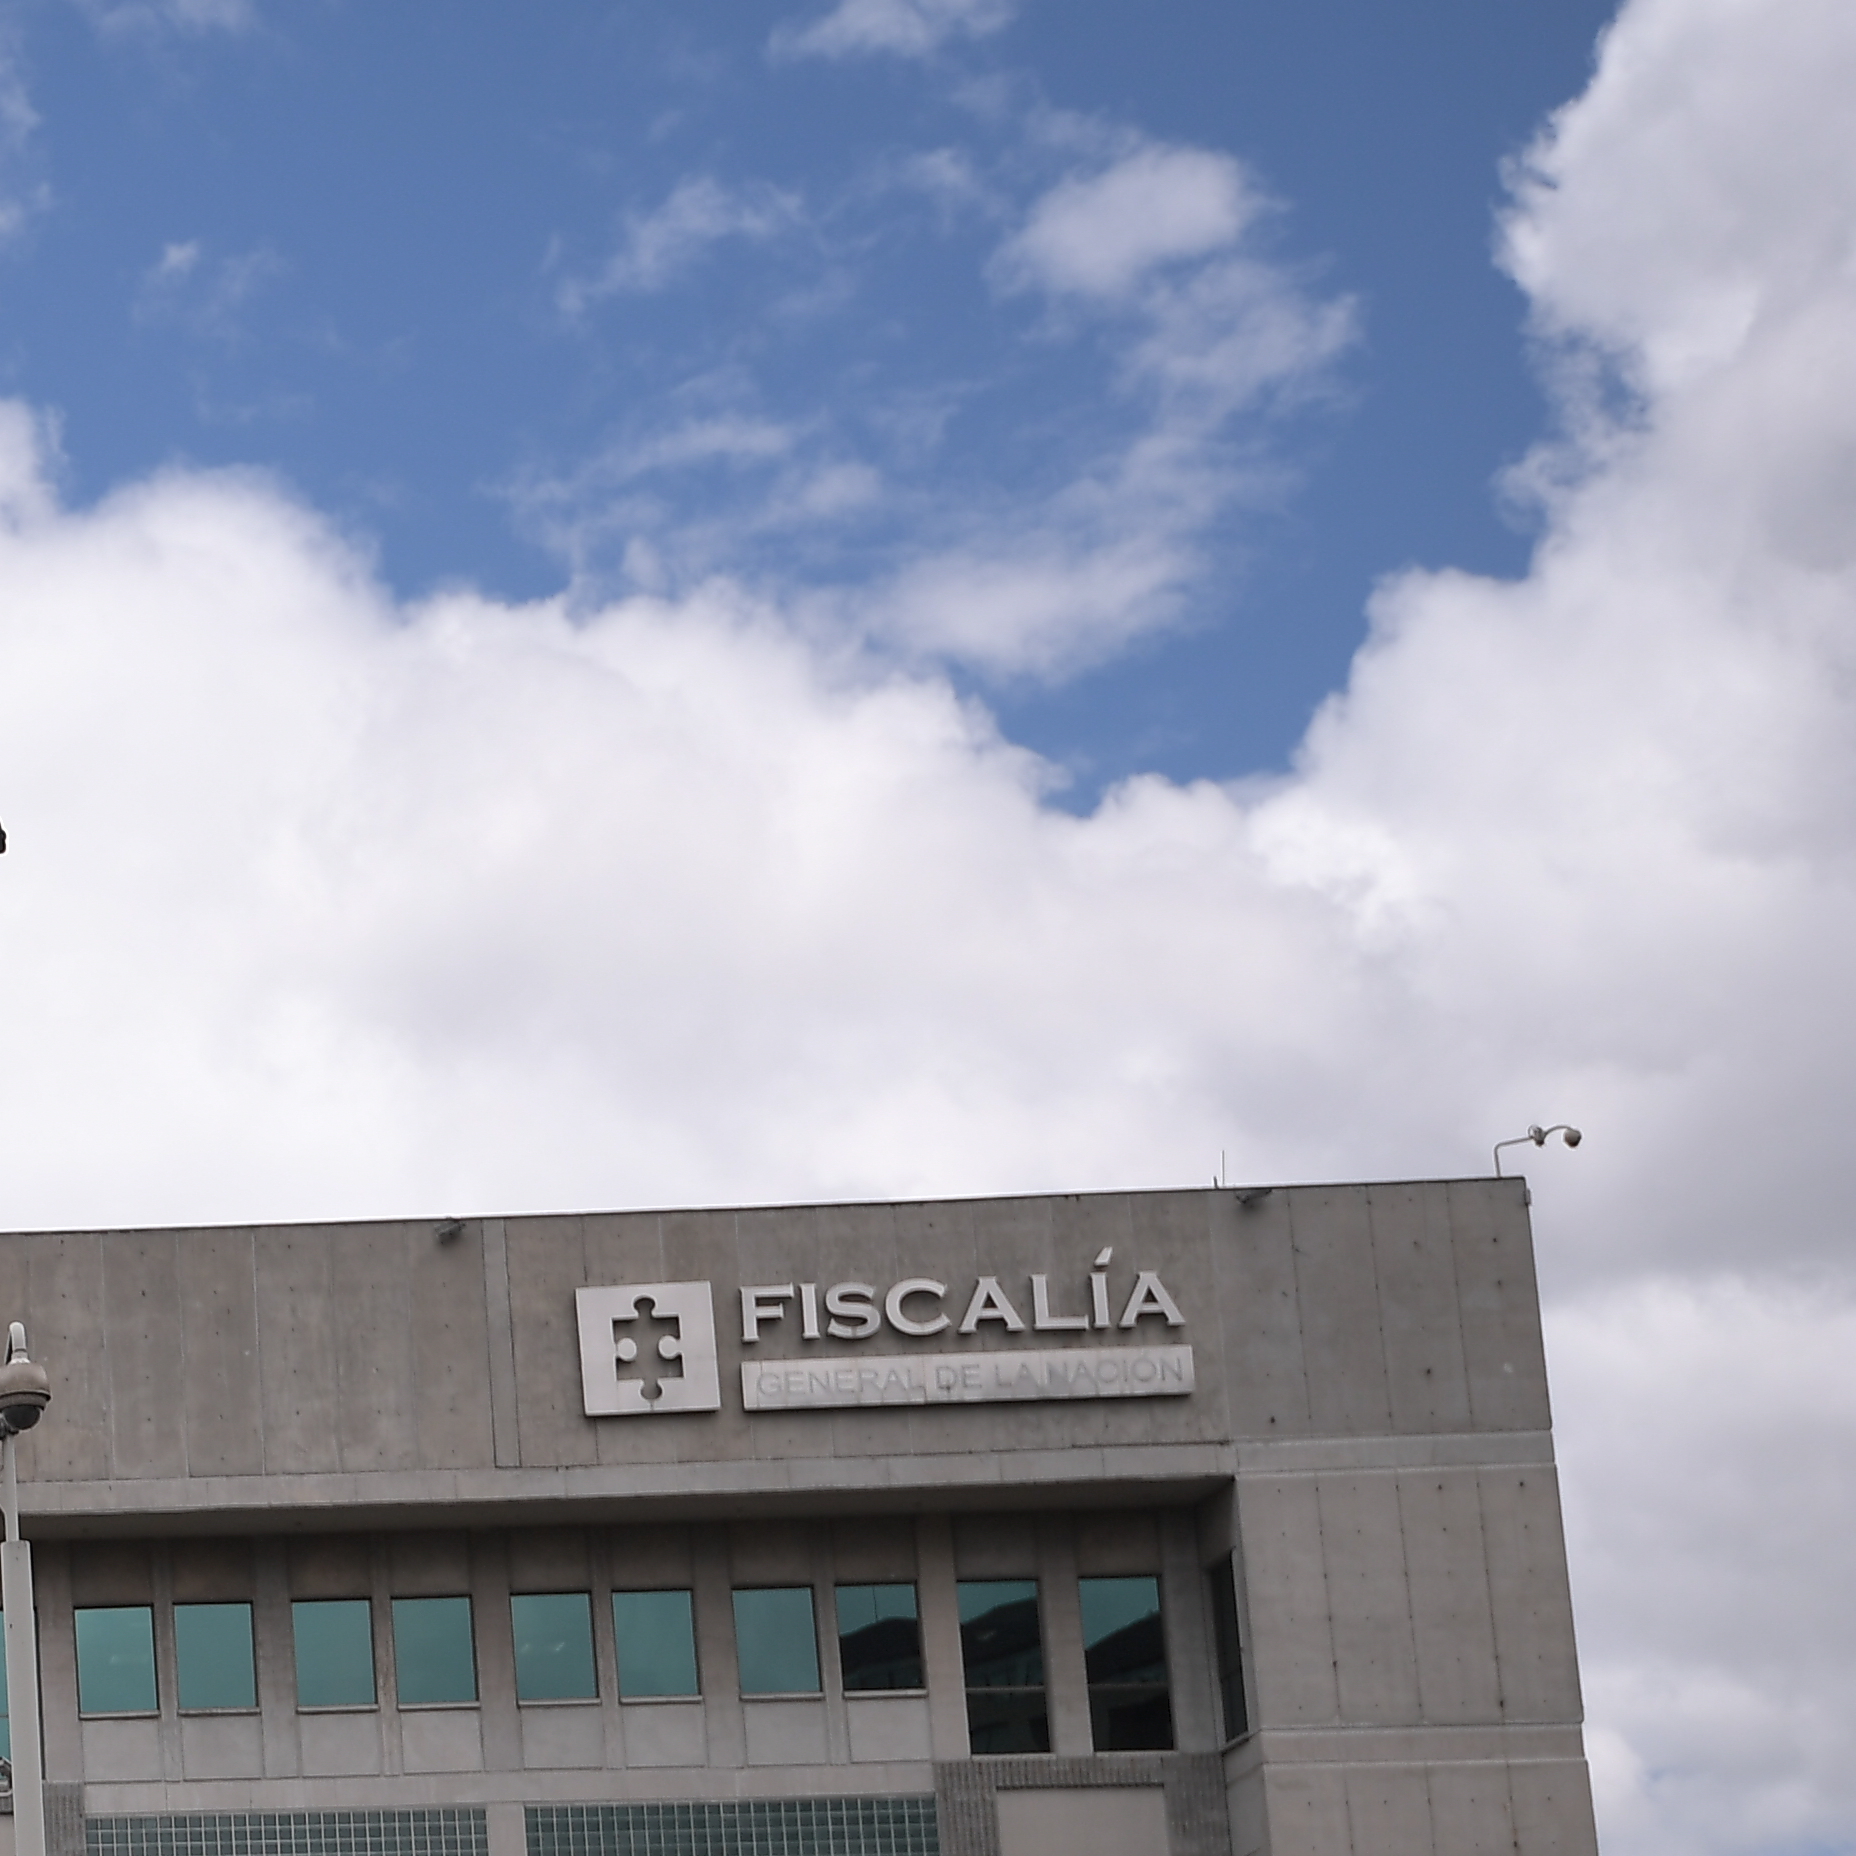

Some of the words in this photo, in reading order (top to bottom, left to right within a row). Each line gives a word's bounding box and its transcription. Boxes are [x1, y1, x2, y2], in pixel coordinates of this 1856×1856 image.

[739, 1245, 1186, 1343] FISCALÍA
[756, 1367, 926, 1397] GENERAL
[935, 1363, 984, 1391] DE
[996, 1360, 1043, 1389] LA
[1046, 1354, 1184, 1388] NACIÓN
